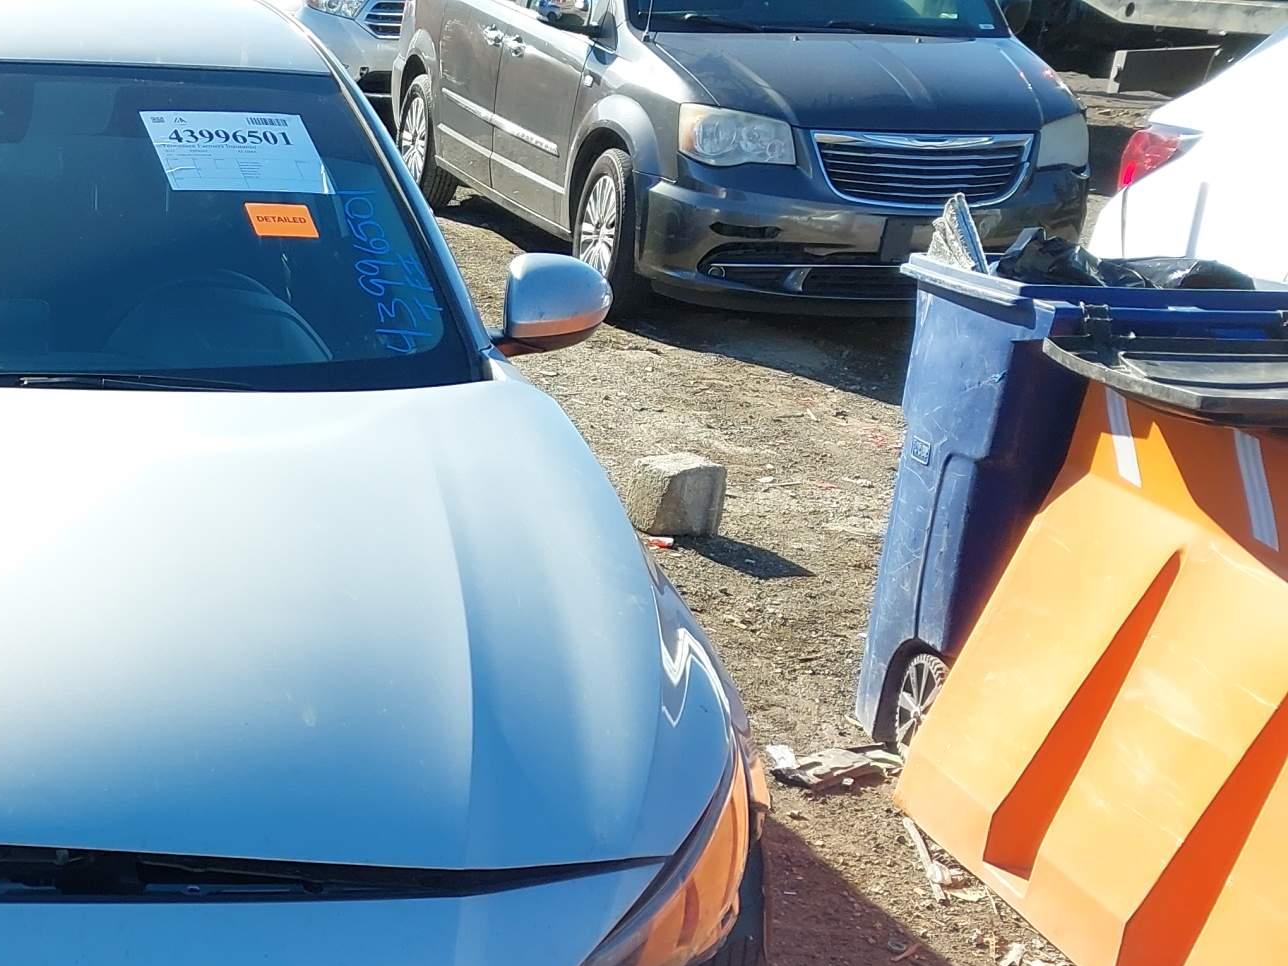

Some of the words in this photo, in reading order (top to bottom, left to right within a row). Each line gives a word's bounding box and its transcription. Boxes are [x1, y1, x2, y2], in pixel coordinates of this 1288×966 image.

[169, 129, 294, 146] 43996501
[256, 214, 307, 225] DETAILED
[334, 190, 433, 354] 43996501
